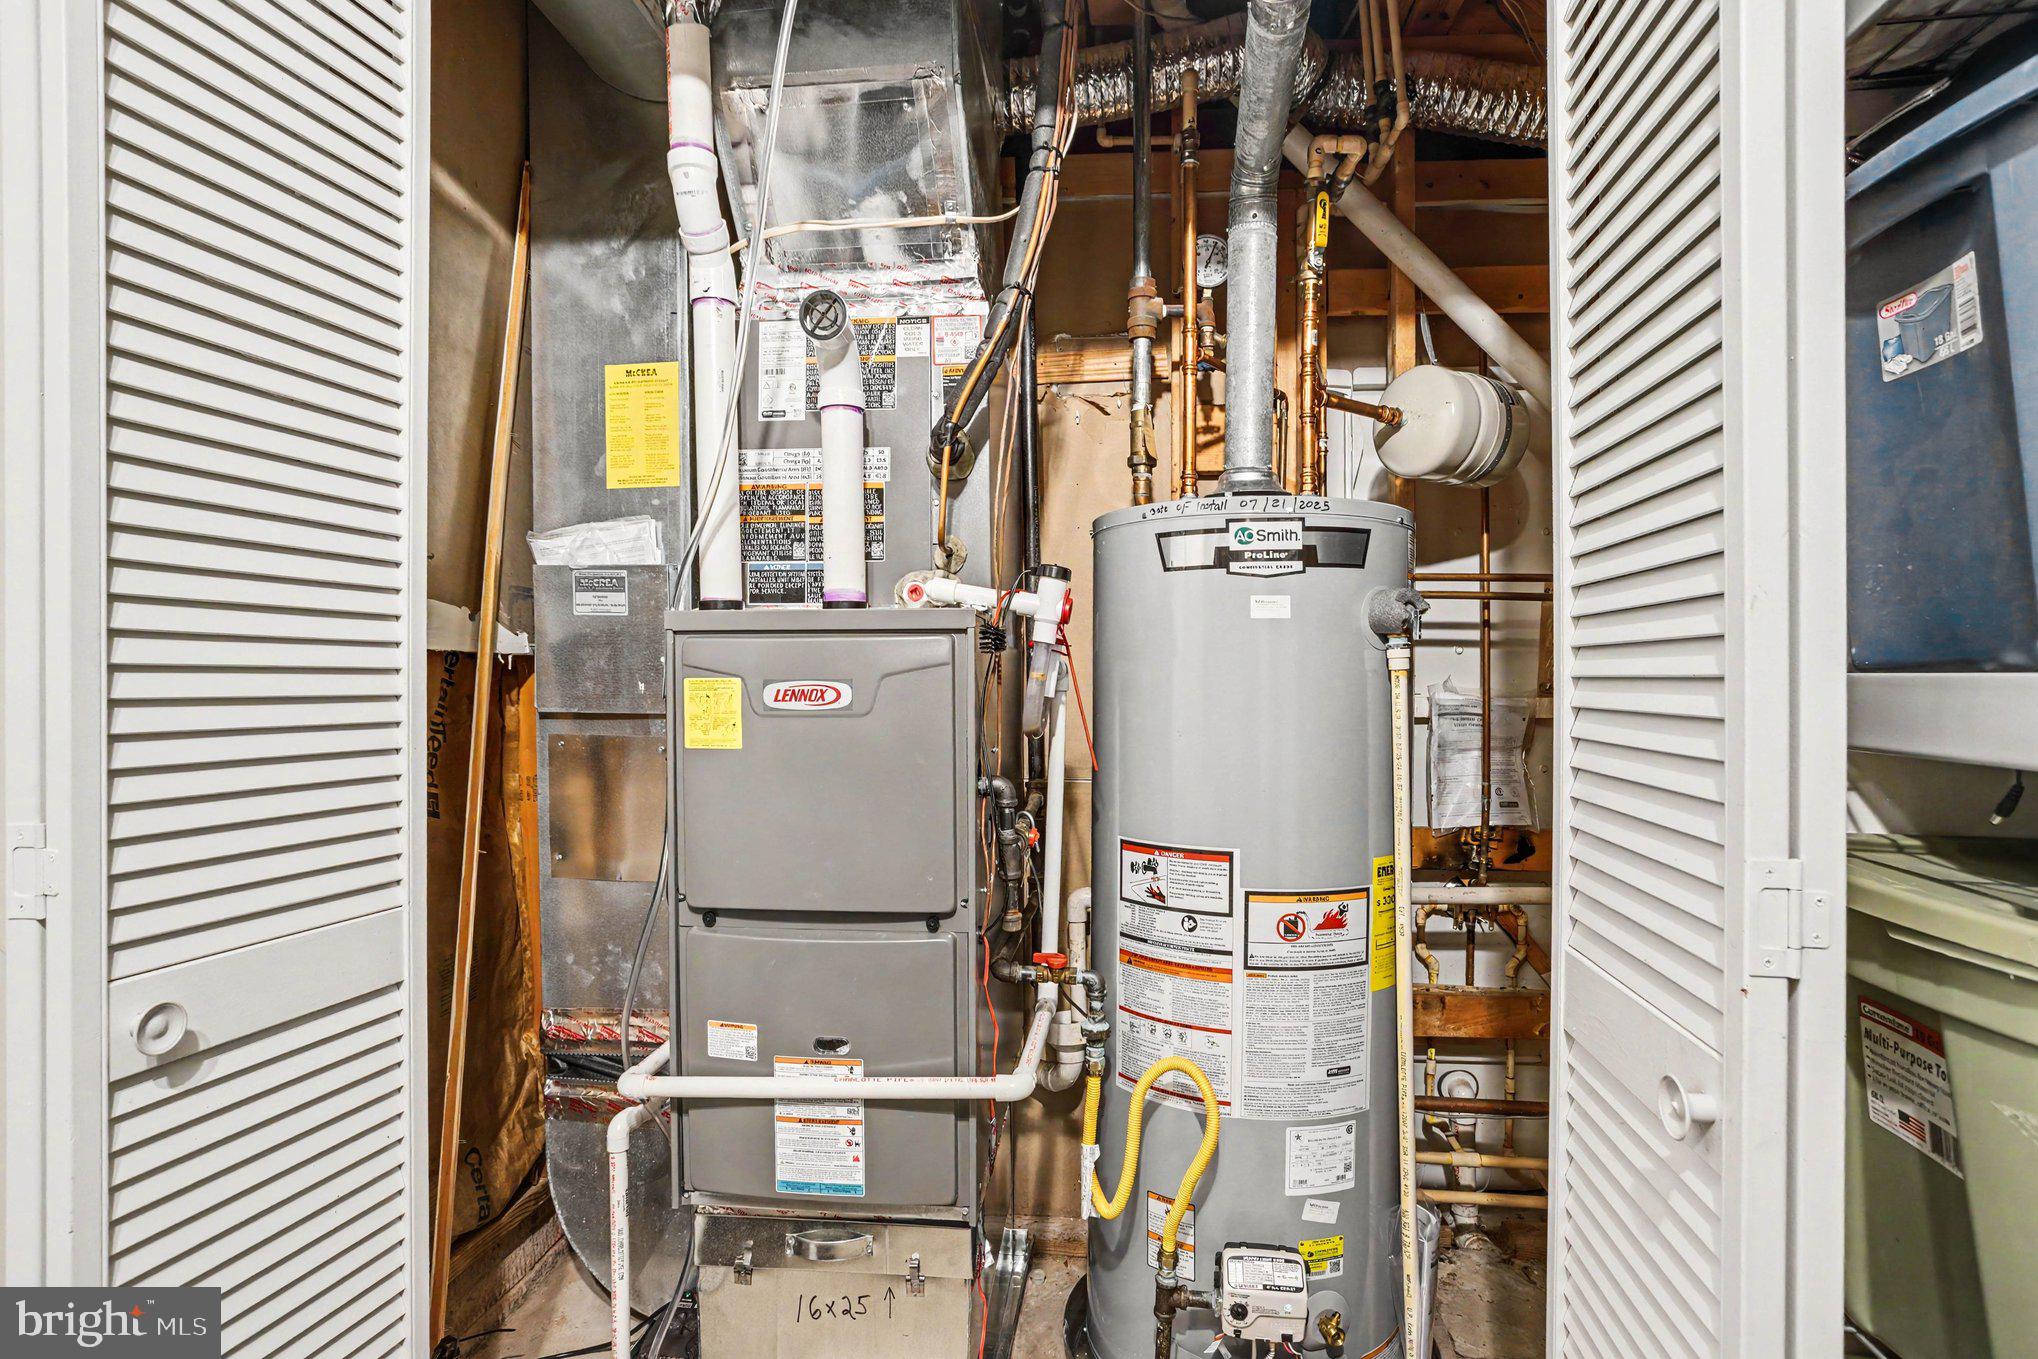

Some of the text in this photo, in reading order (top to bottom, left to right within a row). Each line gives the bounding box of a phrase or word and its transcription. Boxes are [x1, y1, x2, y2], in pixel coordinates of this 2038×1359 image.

[1244, 551, 1287, 560] ProLine
[773, 687, 829, 703] LENNOX
[427, 650, 460, 787] ertainTeed
[1160, 851, 1185, 859] DANGER
[1302, 895, 1330, 903] WARNING
[1863, 1027, 1934, 1075] Multi-Purpose
[464, 1147, 491, 1224] Certa
